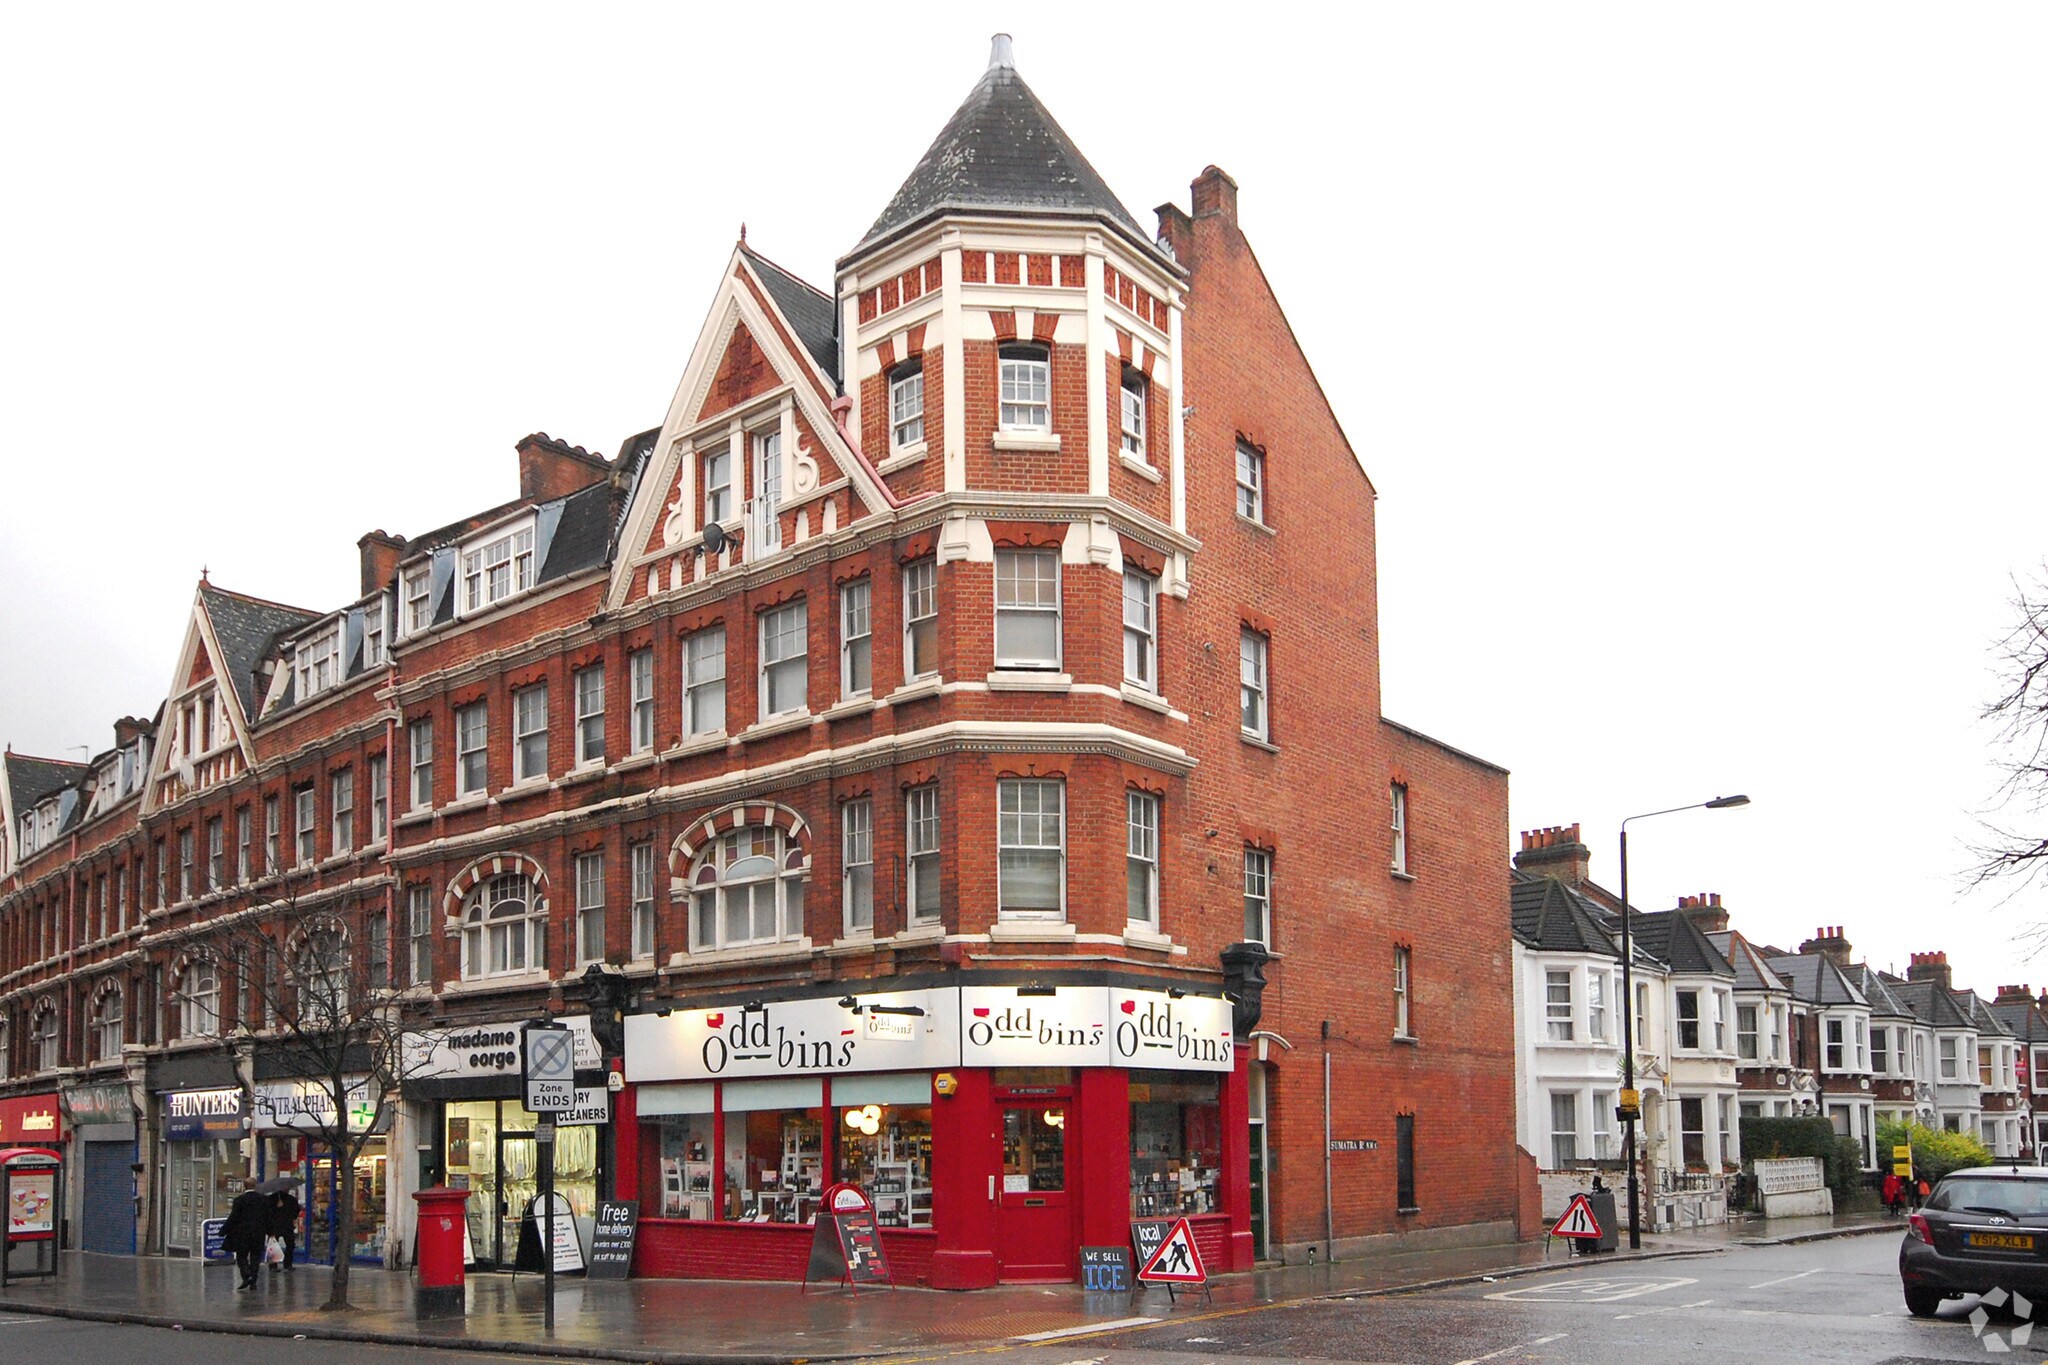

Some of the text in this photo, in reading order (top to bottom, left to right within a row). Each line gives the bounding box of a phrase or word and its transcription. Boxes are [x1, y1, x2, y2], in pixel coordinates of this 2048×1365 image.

[968, 1008, 1104, 1046] Oddbins
[1116, 1002, 1231, 1063] Oddbins
[448, 1029, 516, 1050] madame
[702, 1008, 856, 1074] Oddbins
[469, 1051, 517, 1071] eorge
[540, 1084, 563, 1093] Zone
[170, 1091, 240, 1117] HUNTERS
[533, 1095, 570, 1106] ENDS
[558, 1108, 606, 1122] CLEANERS
[1330, 1140, 1358, 1150] SUMATRA
[602, 1203, 629, 1222] free
[596, 1223, 634, 1238] home delivery
[1138, 1224, 1162, 1242] local
[2003, 1235, 2028, 1248] XLB
[1085, 1251, 1122, 1262] WE SELL
[1082, 1264, 1126, 1291] ICE
